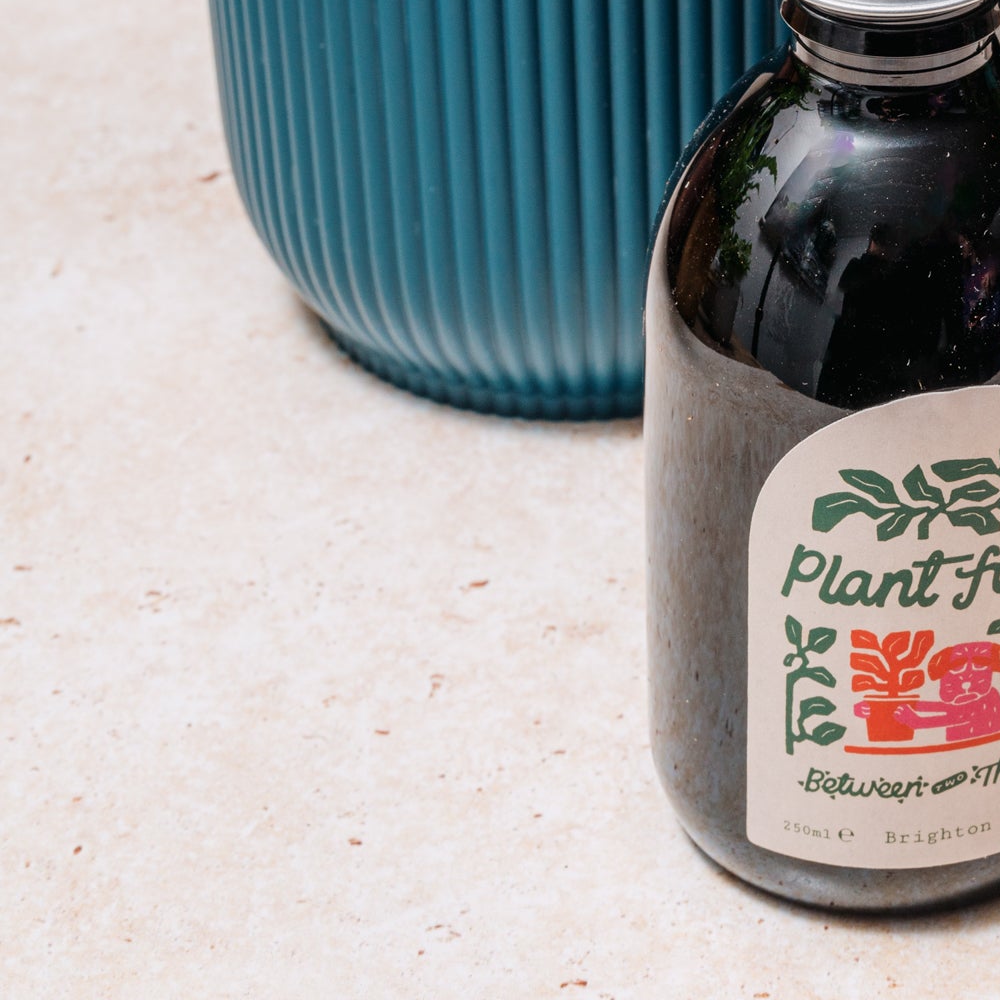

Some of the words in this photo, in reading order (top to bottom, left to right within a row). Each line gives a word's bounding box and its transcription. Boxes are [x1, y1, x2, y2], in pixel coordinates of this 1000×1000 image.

[781, 544, 974, 608] Plant
[804, 767, 926, 799] Between
[933, 772, 966, 793] TWO
[783, 820, 831, 839] 250ml
[885, 821, 991, 844] Brighton
